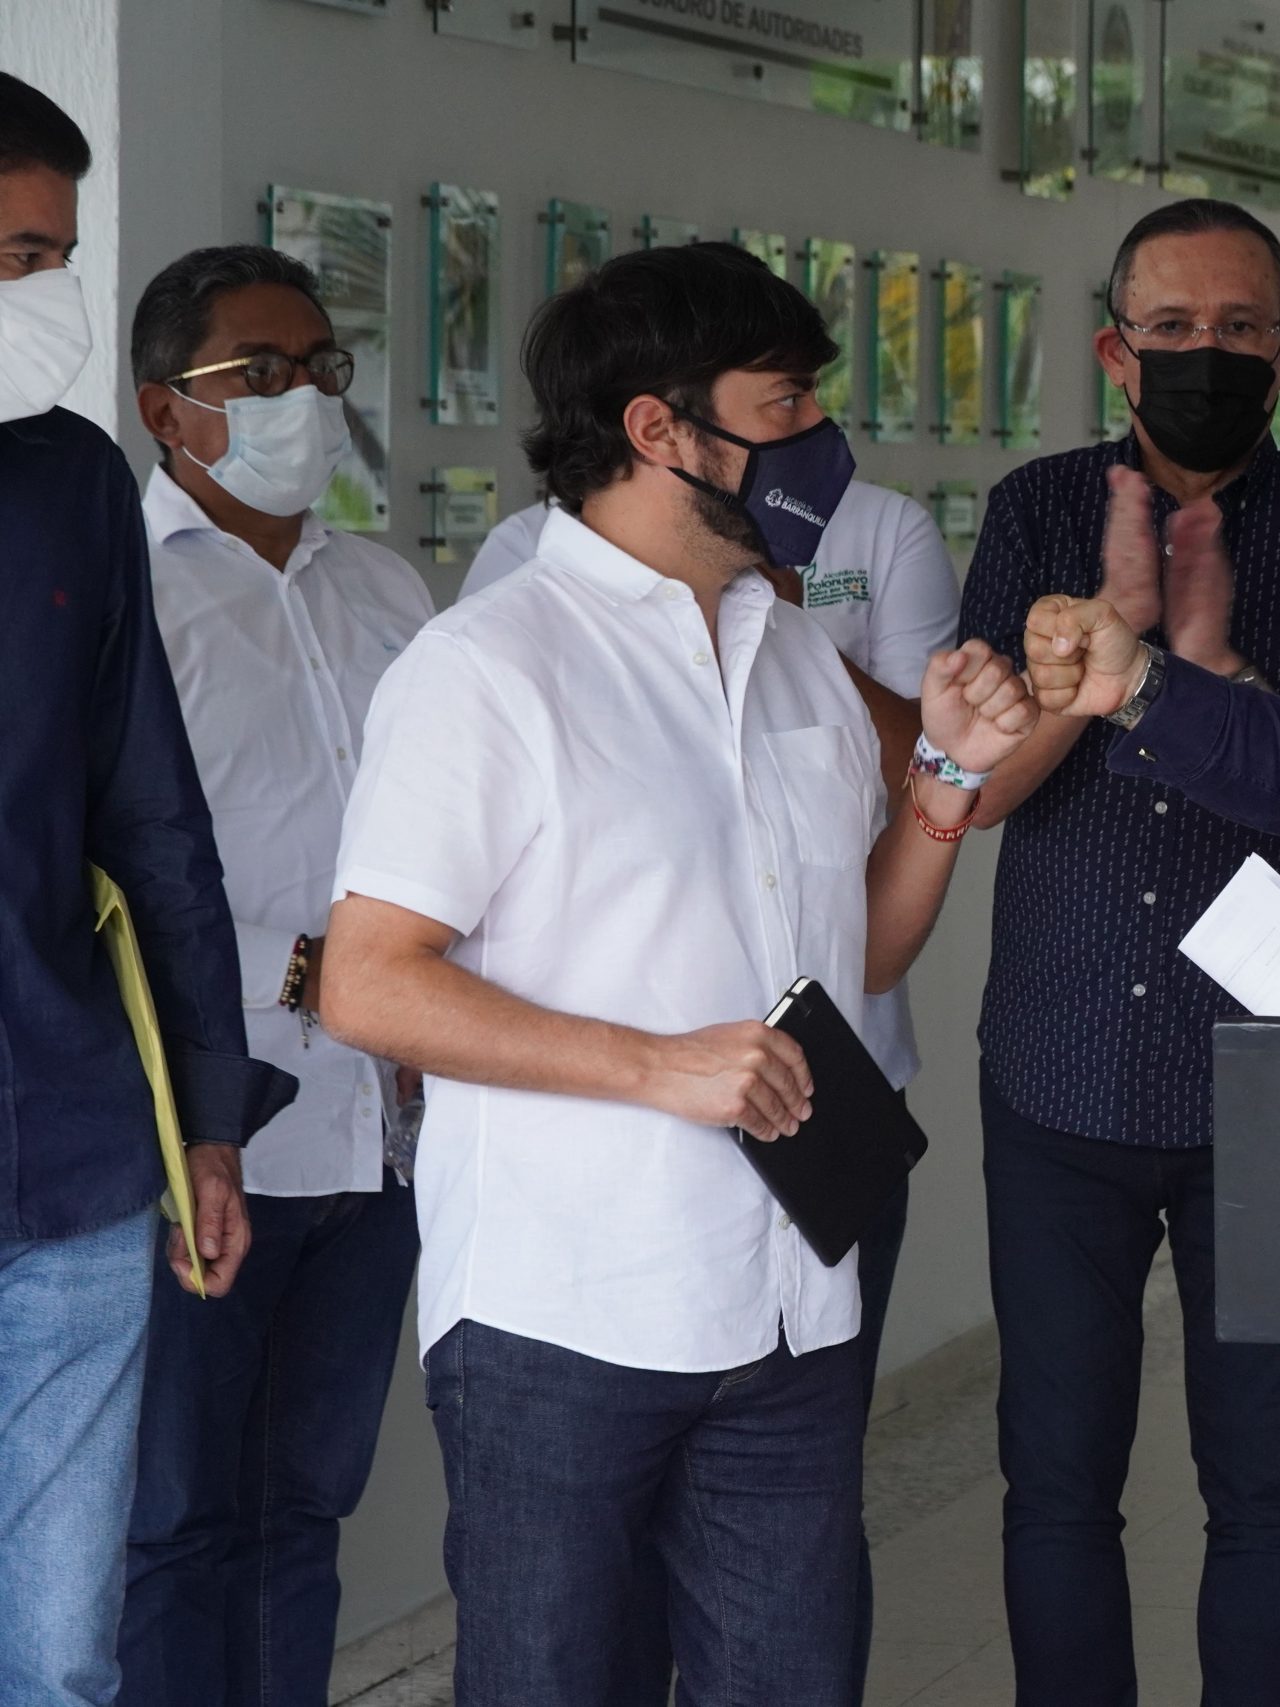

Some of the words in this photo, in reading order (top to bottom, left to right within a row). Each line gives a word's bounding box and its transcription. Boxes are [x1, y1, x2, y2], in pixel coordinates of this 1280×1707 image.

[720, 0, 745, 28] DE
[747, 7, 863, 59] AUTORIDADES
[782, 502, 826, 527] BARRANQUILLA
[807, 577, 867, 591] Polonuevo
